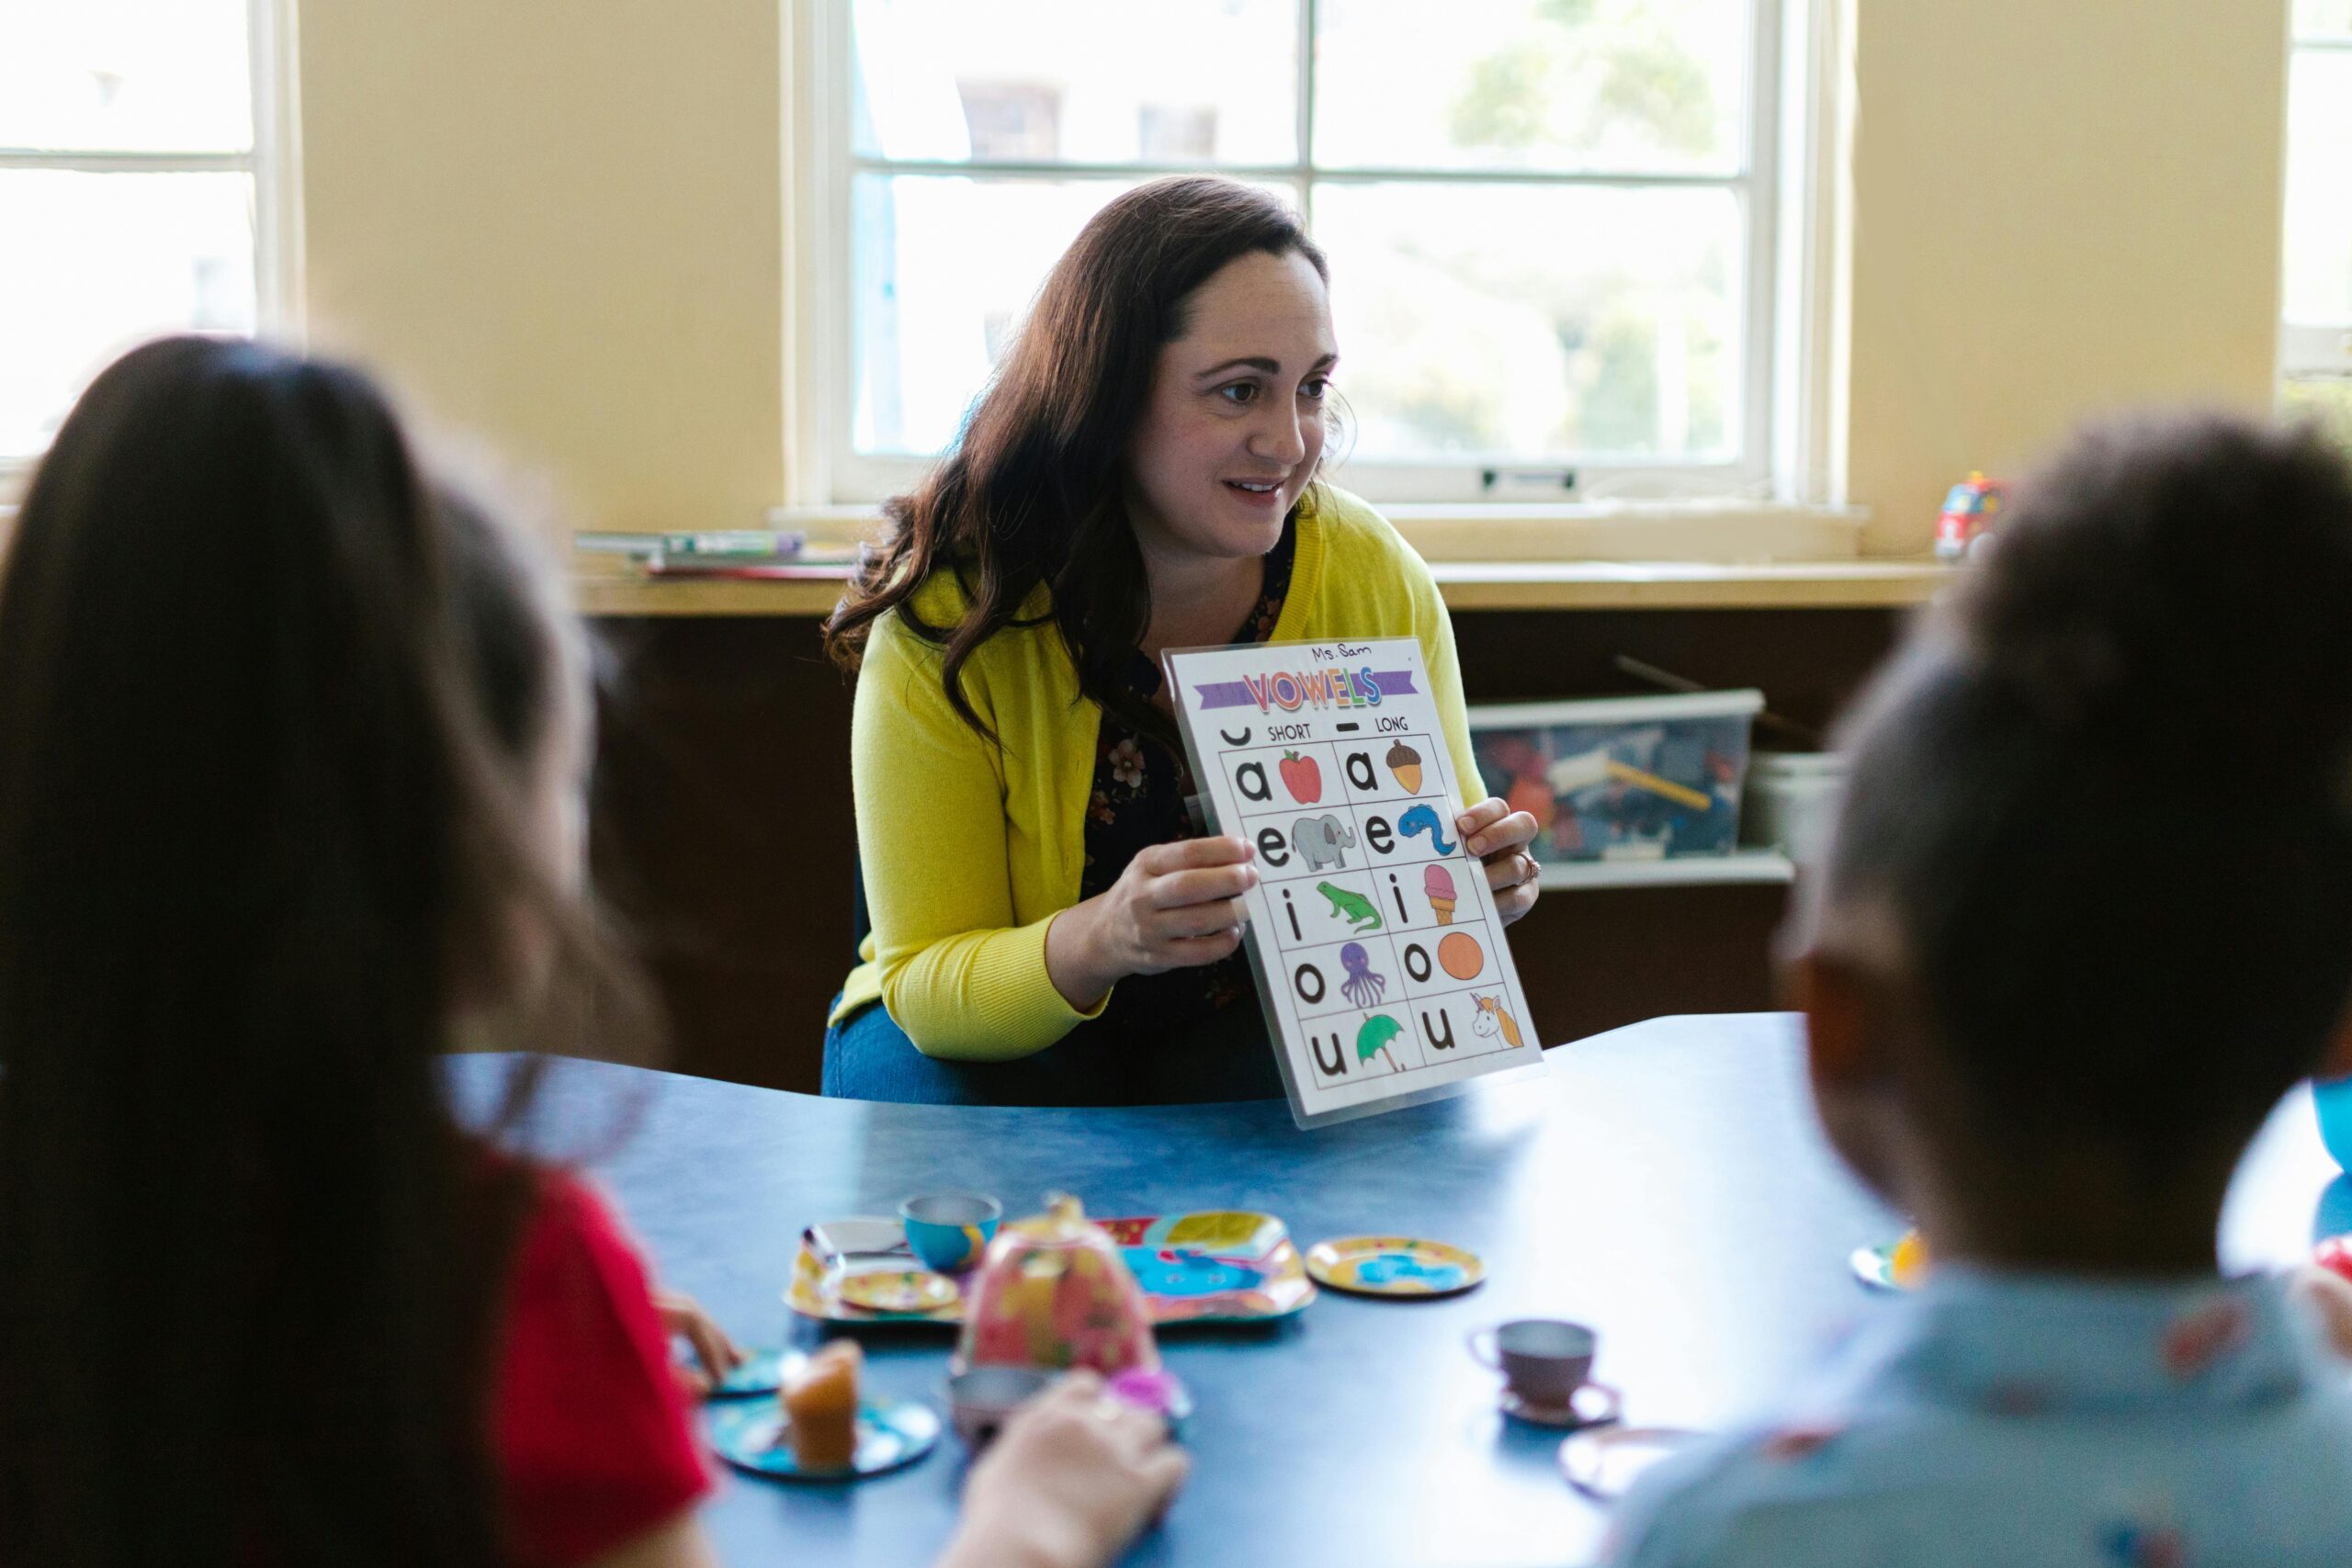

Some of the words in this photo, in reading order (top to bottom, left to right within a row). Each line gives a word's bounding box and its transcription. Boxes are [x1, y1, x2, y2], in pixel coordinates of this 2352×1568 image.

[1311, 647, 1339, 662] Ms.
[1337, 643, 1373, 659] Sam
[1243, 666, 1382, 713] VOWELS
[1268, 723, 1311, 741] SHORT
[1374, 716, 1408, 732] LONG
[1236, 761, 1273, 802] a
[1345, 751, 1379, 791] a
[1257, 827, 1291, 868] e
[1365, 816, 1396, 855] e
[1282, 888, 1303, 942] i
[1388, 873, 1409, 924] i
[1294, 963, 1326, 1005] o
[1404, 942, 1432, 983] o
[1311, 1032, 1348, 1077] u
[1421, 1008, 1456, 1051] u
